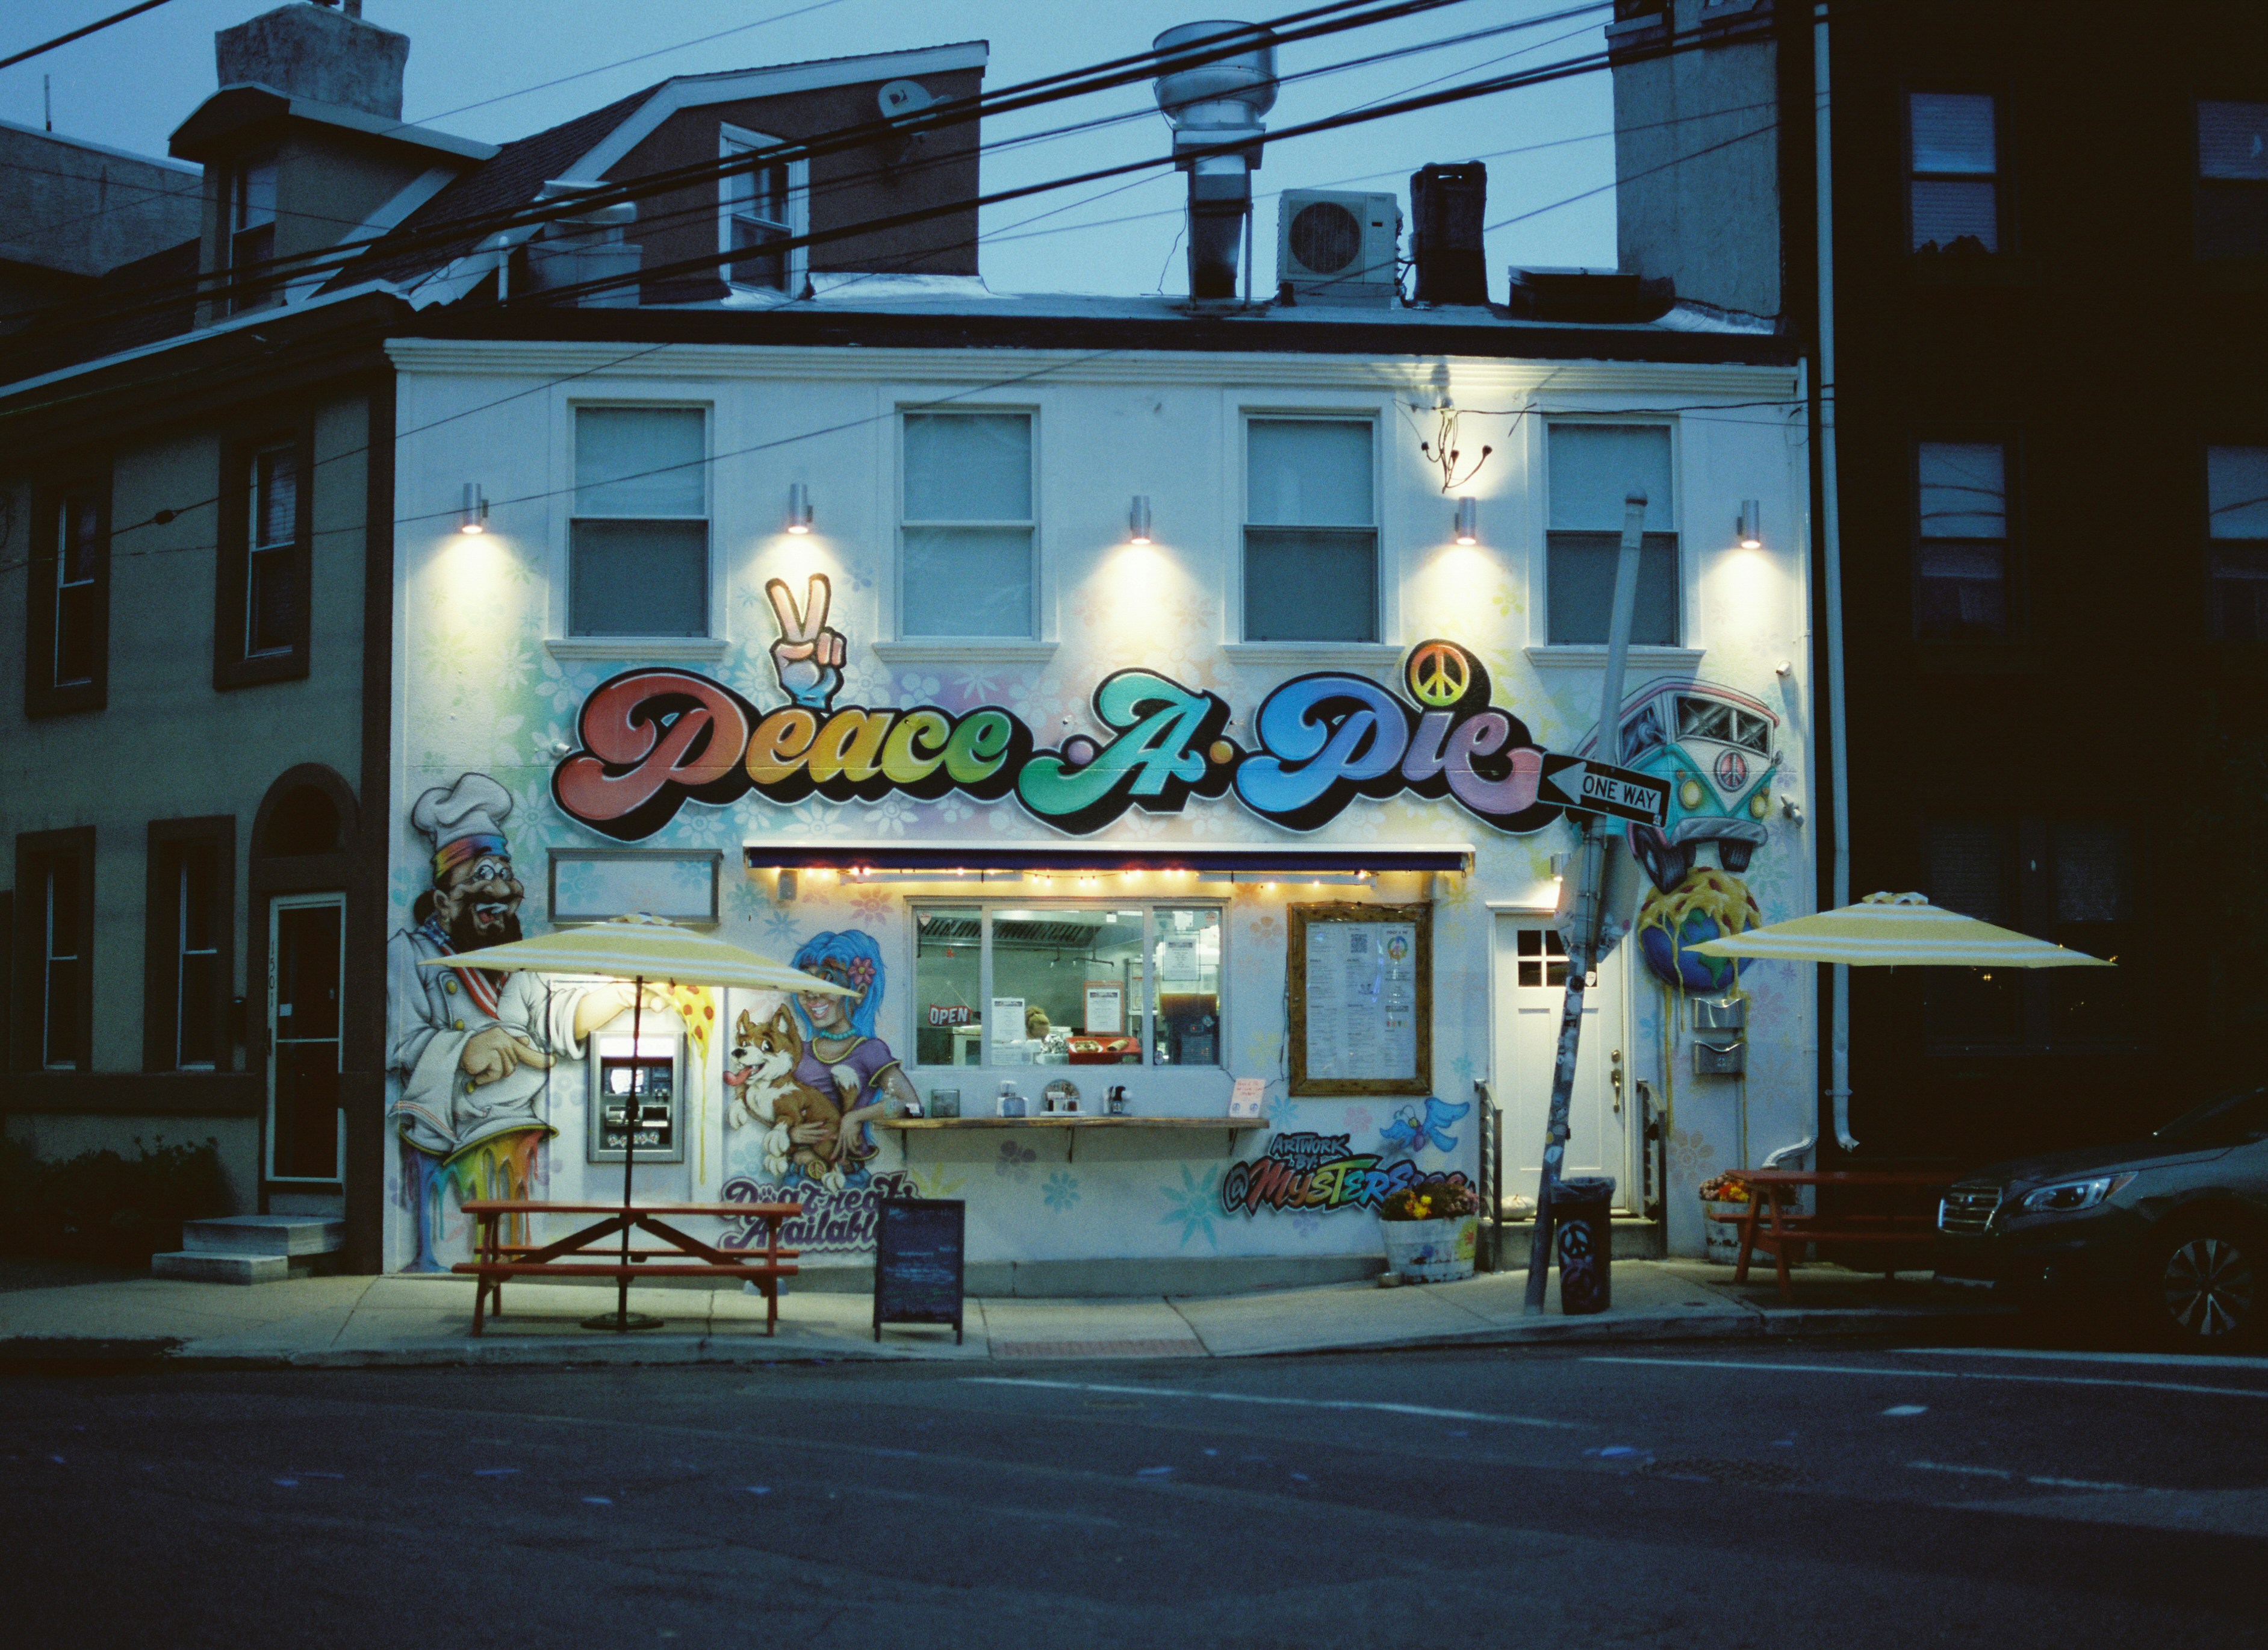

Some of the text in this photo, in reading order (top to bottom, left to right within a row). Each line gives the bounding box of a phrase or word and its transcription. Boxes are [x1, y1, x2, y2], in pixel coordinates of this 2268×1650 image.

[553, 641, 1545, 831] Peace A Pie
[1582, 775, 1657, 809] ONE WAY
[930, 1007, 968, 1024] OPEN
[1272, 1134, 1350, 1157] ARTWORK
[723, 1209, 880, 1249] Aailabl
